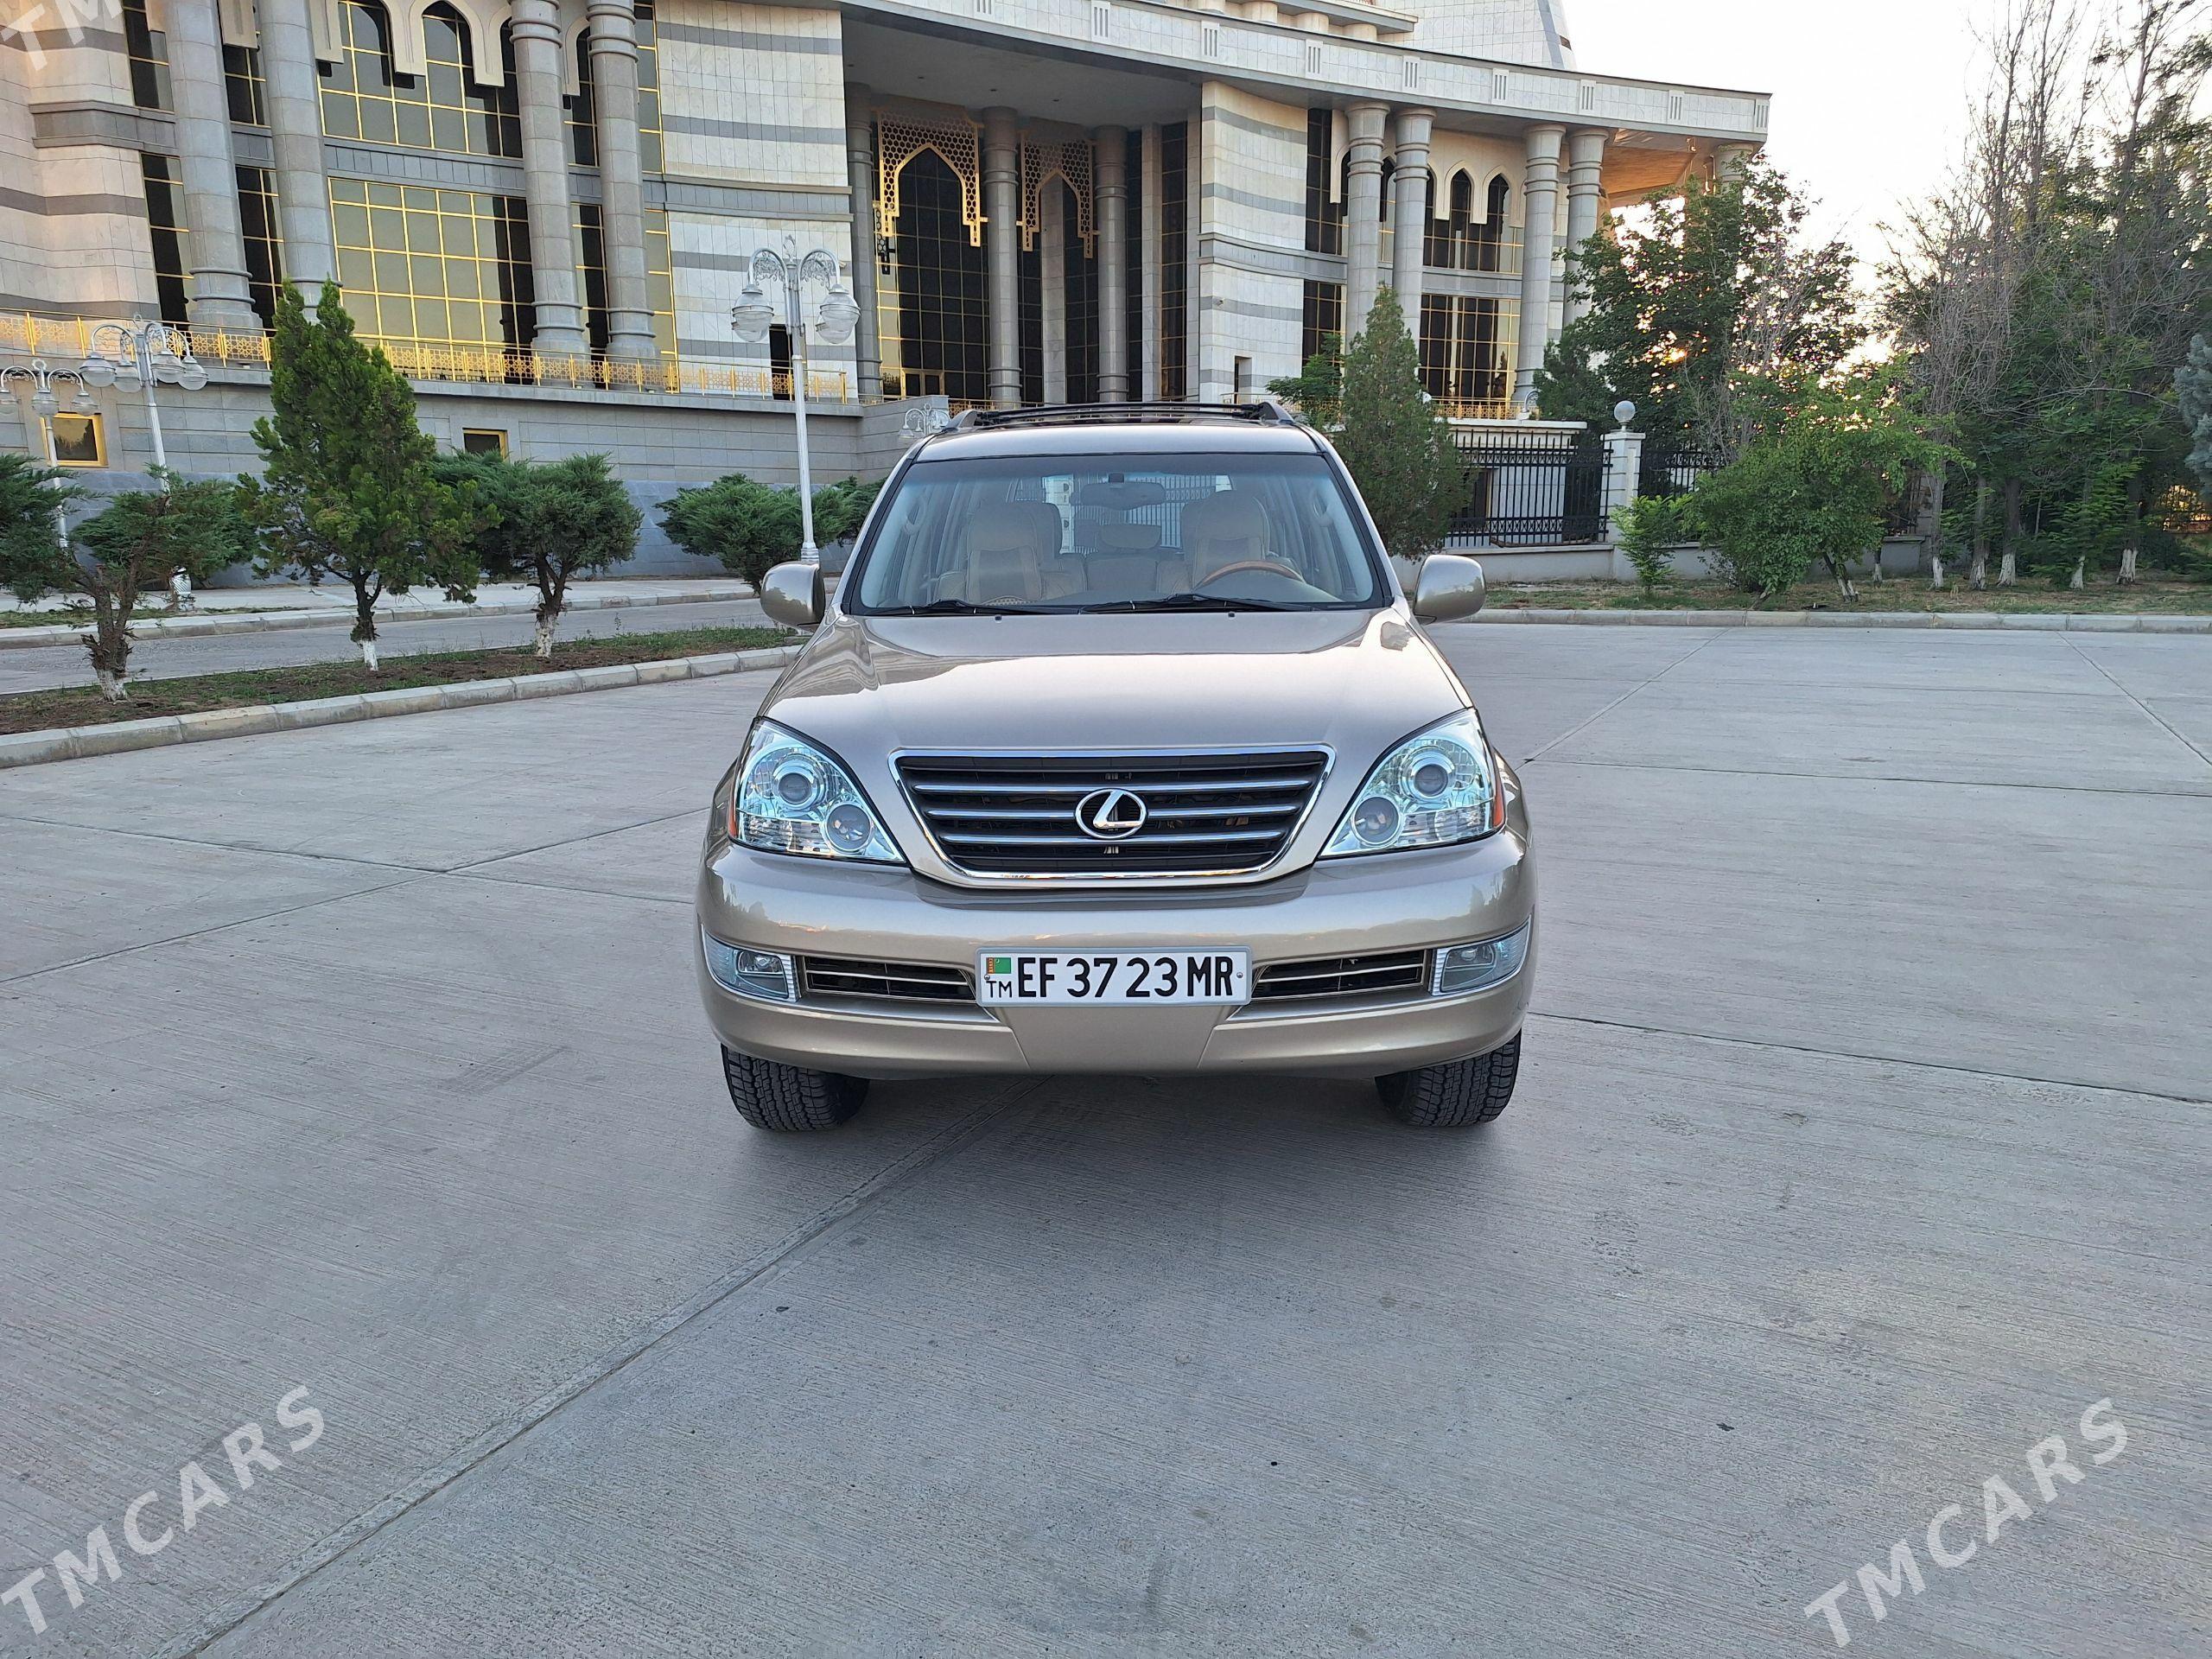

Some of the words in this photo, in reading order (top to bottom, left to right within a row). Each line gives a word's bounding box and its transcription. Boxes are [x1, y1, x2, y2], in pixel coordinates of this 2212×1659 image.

[985, 980, 1013, 999] TM
[1017, 957, 1058, 998] EF
[1065, 957, 1118, 998] 37
[1125, 957, 1179, 998] 23
[1186, 956, 1234, 997] MR
